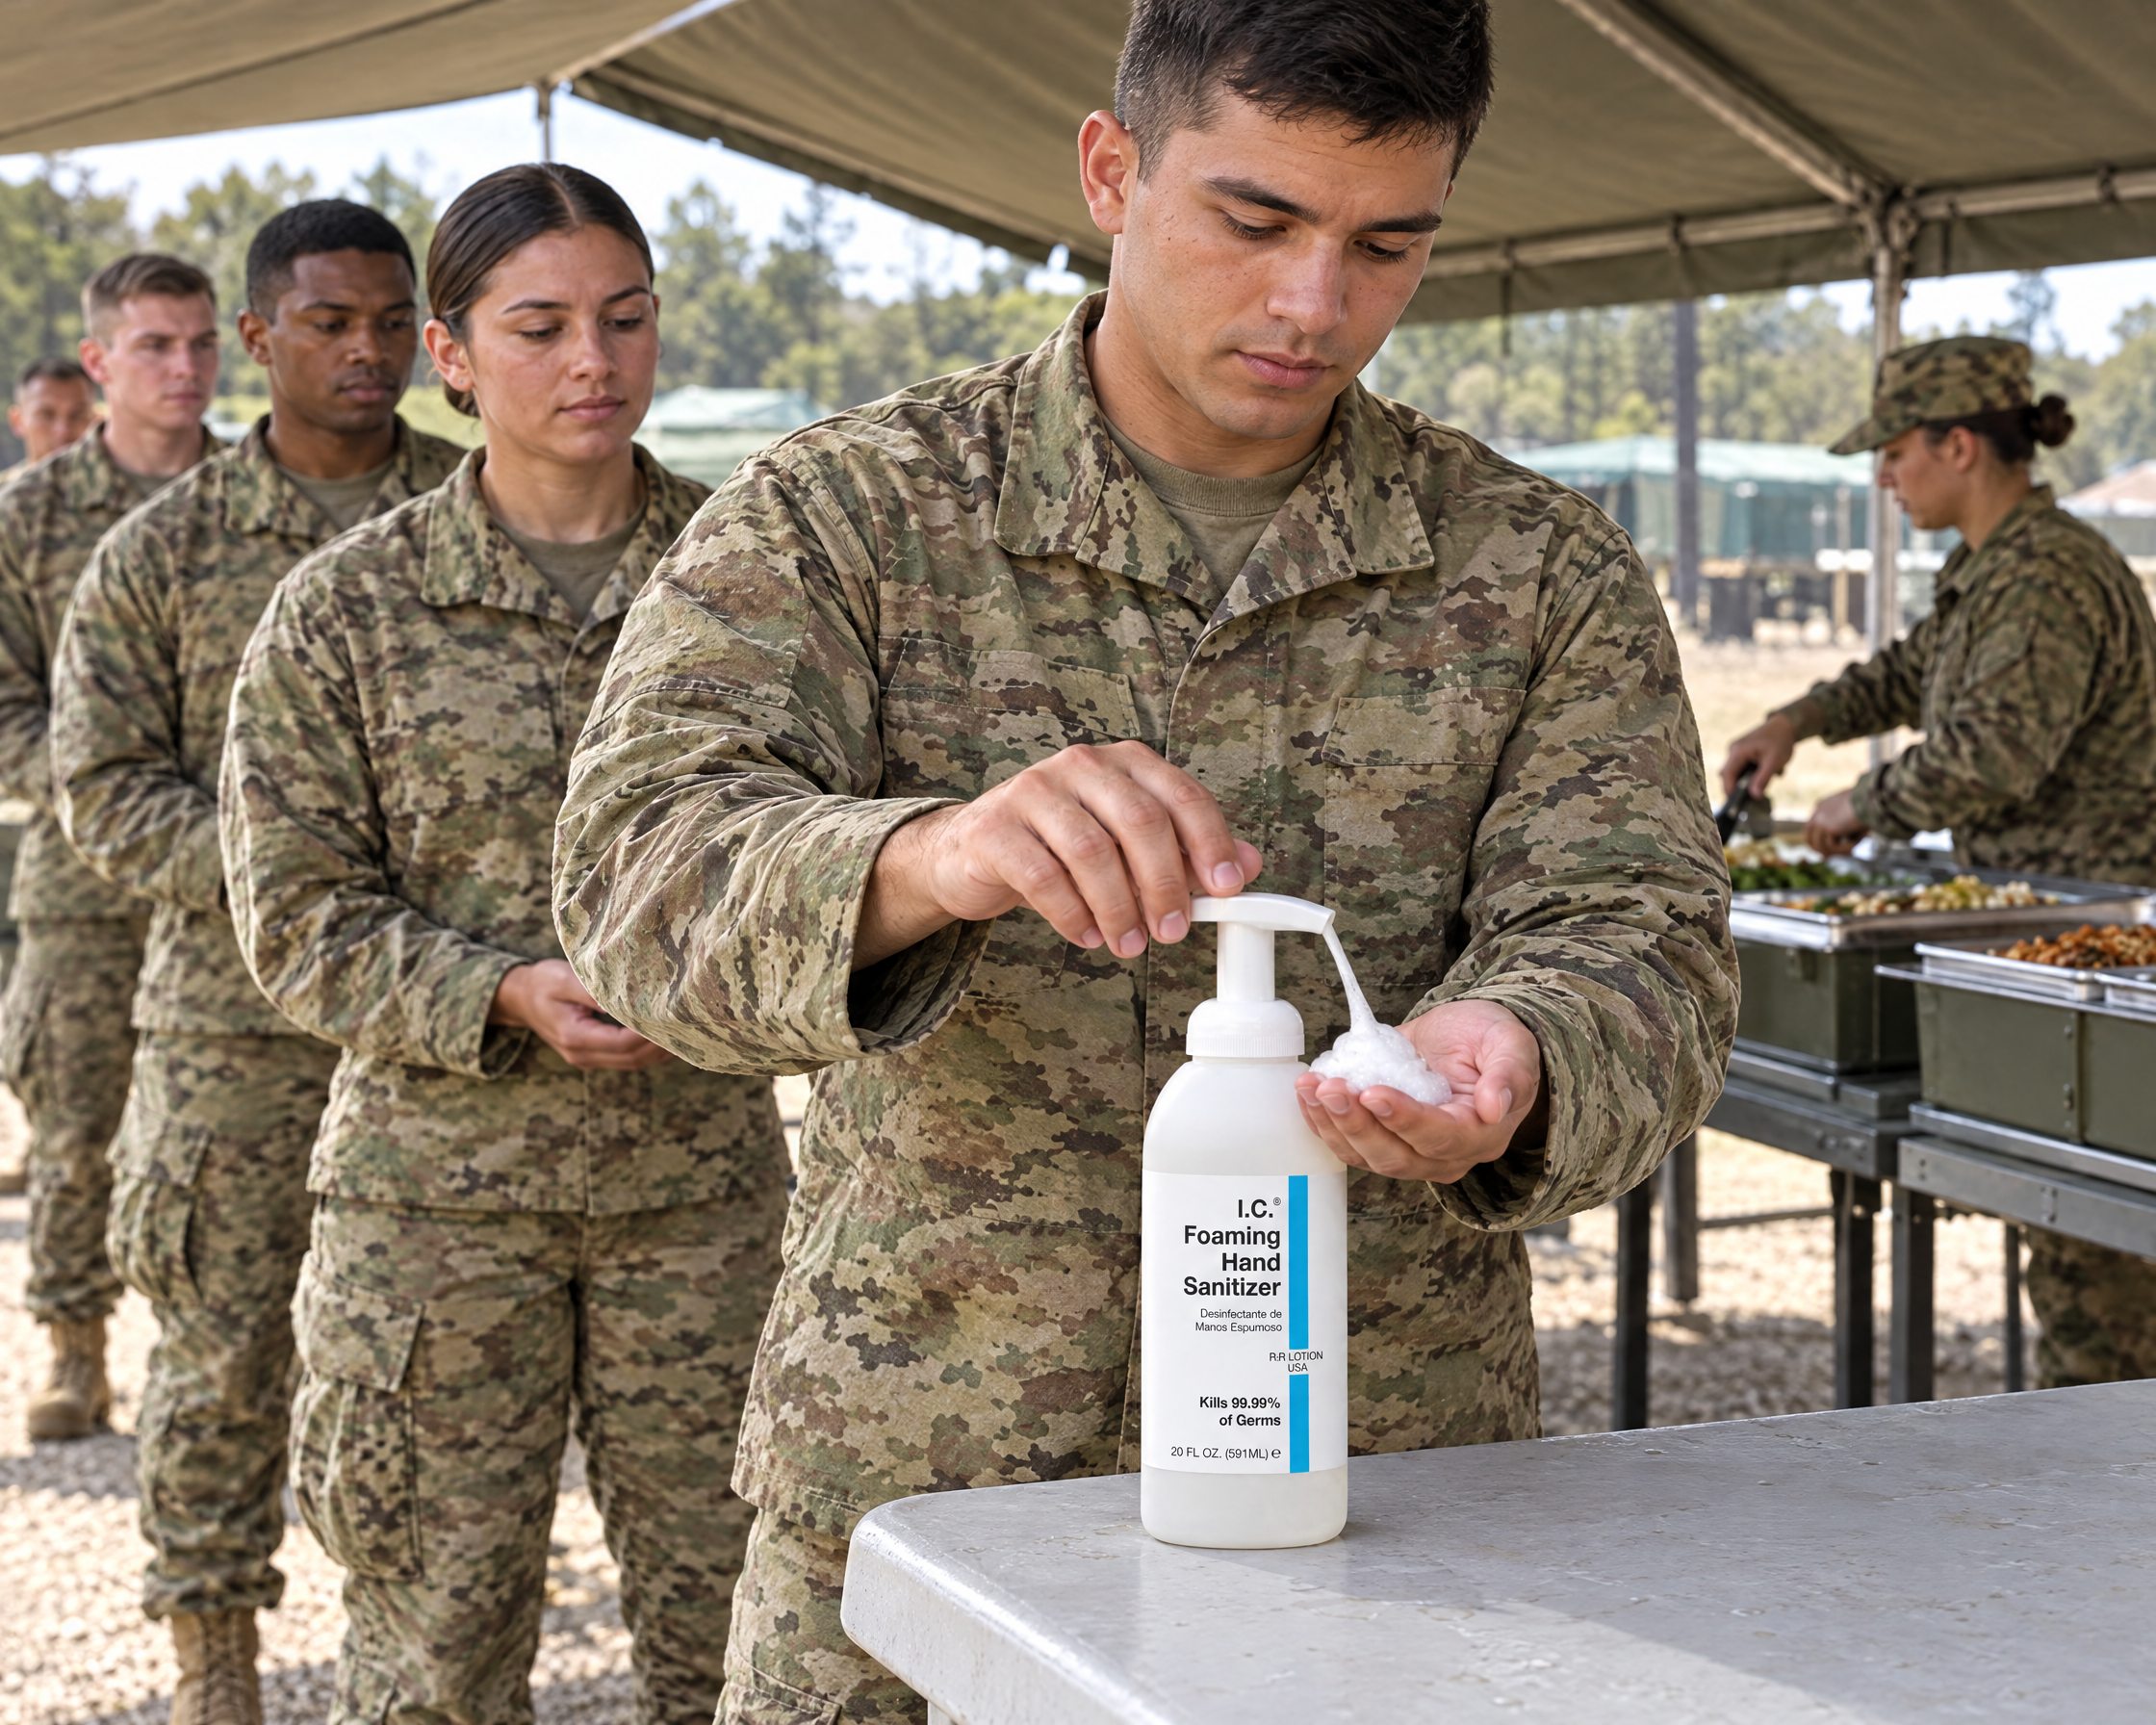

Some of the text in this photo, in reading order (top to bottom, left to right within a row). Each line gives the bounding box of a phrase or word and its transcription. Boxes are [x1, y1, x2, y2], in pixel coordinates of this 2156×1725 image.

[1184, 1224, 1281, 1250] Foaming
[1221, 1252, 1281, 1272] Hand
[1183, 1275, 1282, 1297] Sanitizer
[1200, 1308, 1283, 1319] Desinfectante de
[1195, 1322, 1283, 1334] Manos Espumoso
[1288, 1351, 1323, 1362] LOTION
[1287, 1362, 1309, 1373] USA
[1199, 1396, 1281, 1409] Kills 99.99%
[1219, 1413, 1281, 1427] of Germs
[1170, 1446, 1184, 1457] 20
[1186, 1446, 1200, 1458] FL
[1202, 1447, 1222, 1458] OZ.
[1224, 1448, 1269, 1461] (591ML)
